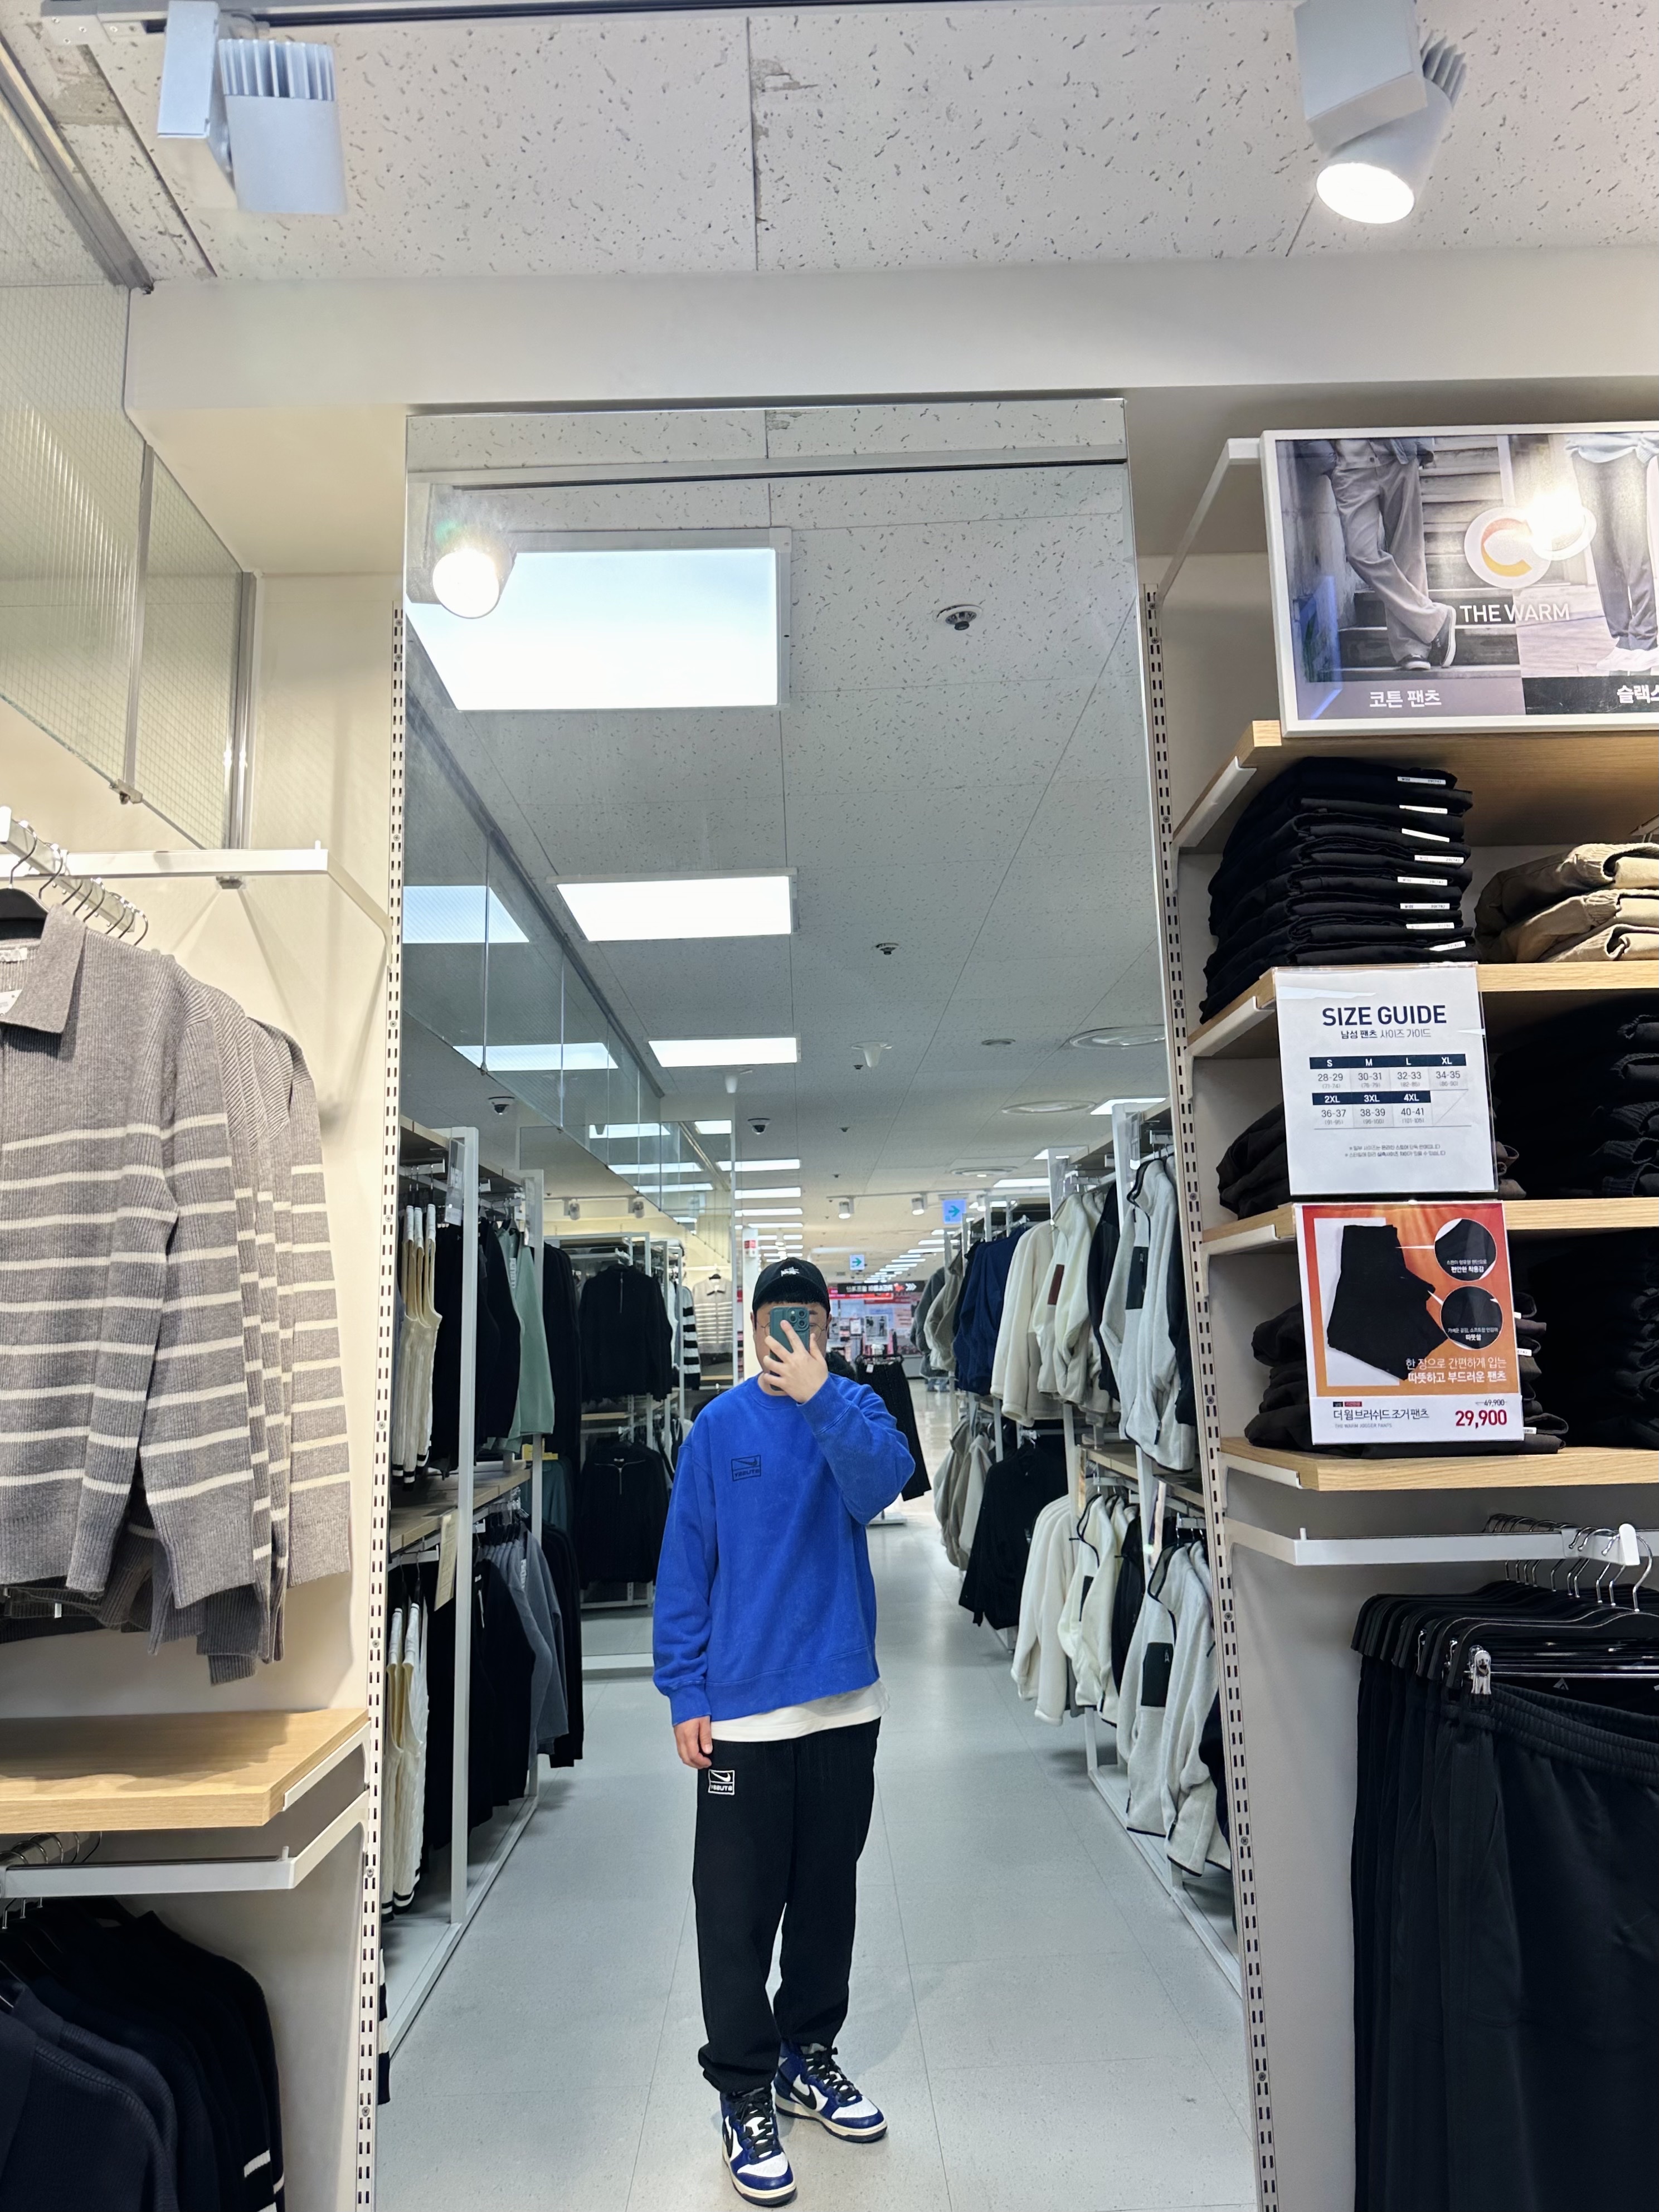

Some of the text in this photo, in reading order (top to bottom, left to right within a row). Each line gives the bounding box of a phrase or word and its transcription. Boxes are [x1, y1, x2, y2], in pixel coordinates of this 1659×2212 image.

[1459, 604, 1570, 623] THE WARM
[1369, 689, 1442, 708] 코튼 팬츠
[1322, 1005, 1447, 1026] SIZE GUIDE
[1341, 1029, 1432, 1039] 남성 팬츠 사이즈 가이드
[1358, 1072, 1381, 1081] 30-31
[1405, 1357, 1507, 1370] 한 장으로 간편하게 입는
[1408, 1370, 1507, 1384] 따뜻하고 부드러운 팬츠
[1334, 1408, 1429, 1421] 더 웜 브러쉬드 조거 팬츠
[1455, 1409, 1507, 1429] 29,900
